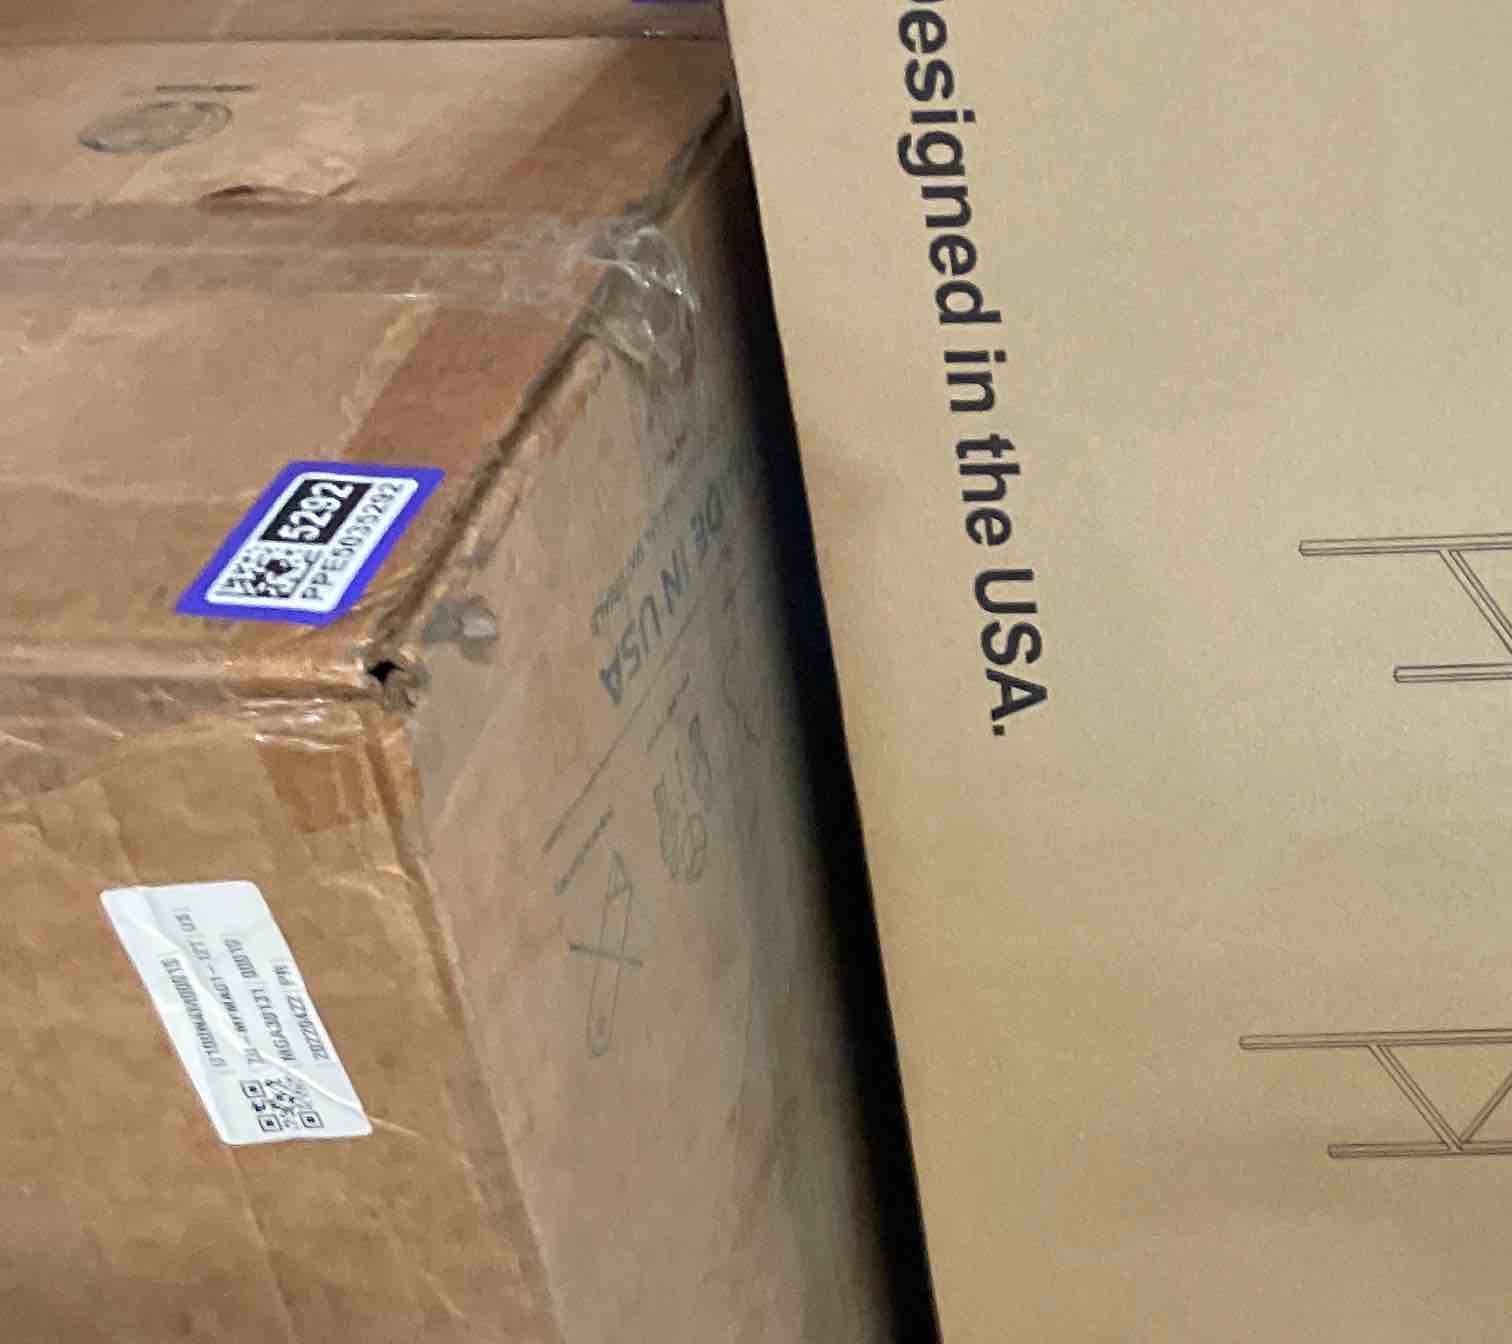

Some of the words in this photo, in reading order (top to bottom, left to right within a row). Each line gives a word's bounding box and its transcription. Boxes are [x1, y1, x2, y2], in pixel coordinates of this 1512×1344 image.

[944, 350, 1007, 413] in
[277, 481, 355, 541] 5292
[954, 433, 1022, 547] the
[973, 567, 1049, 737] USA.
